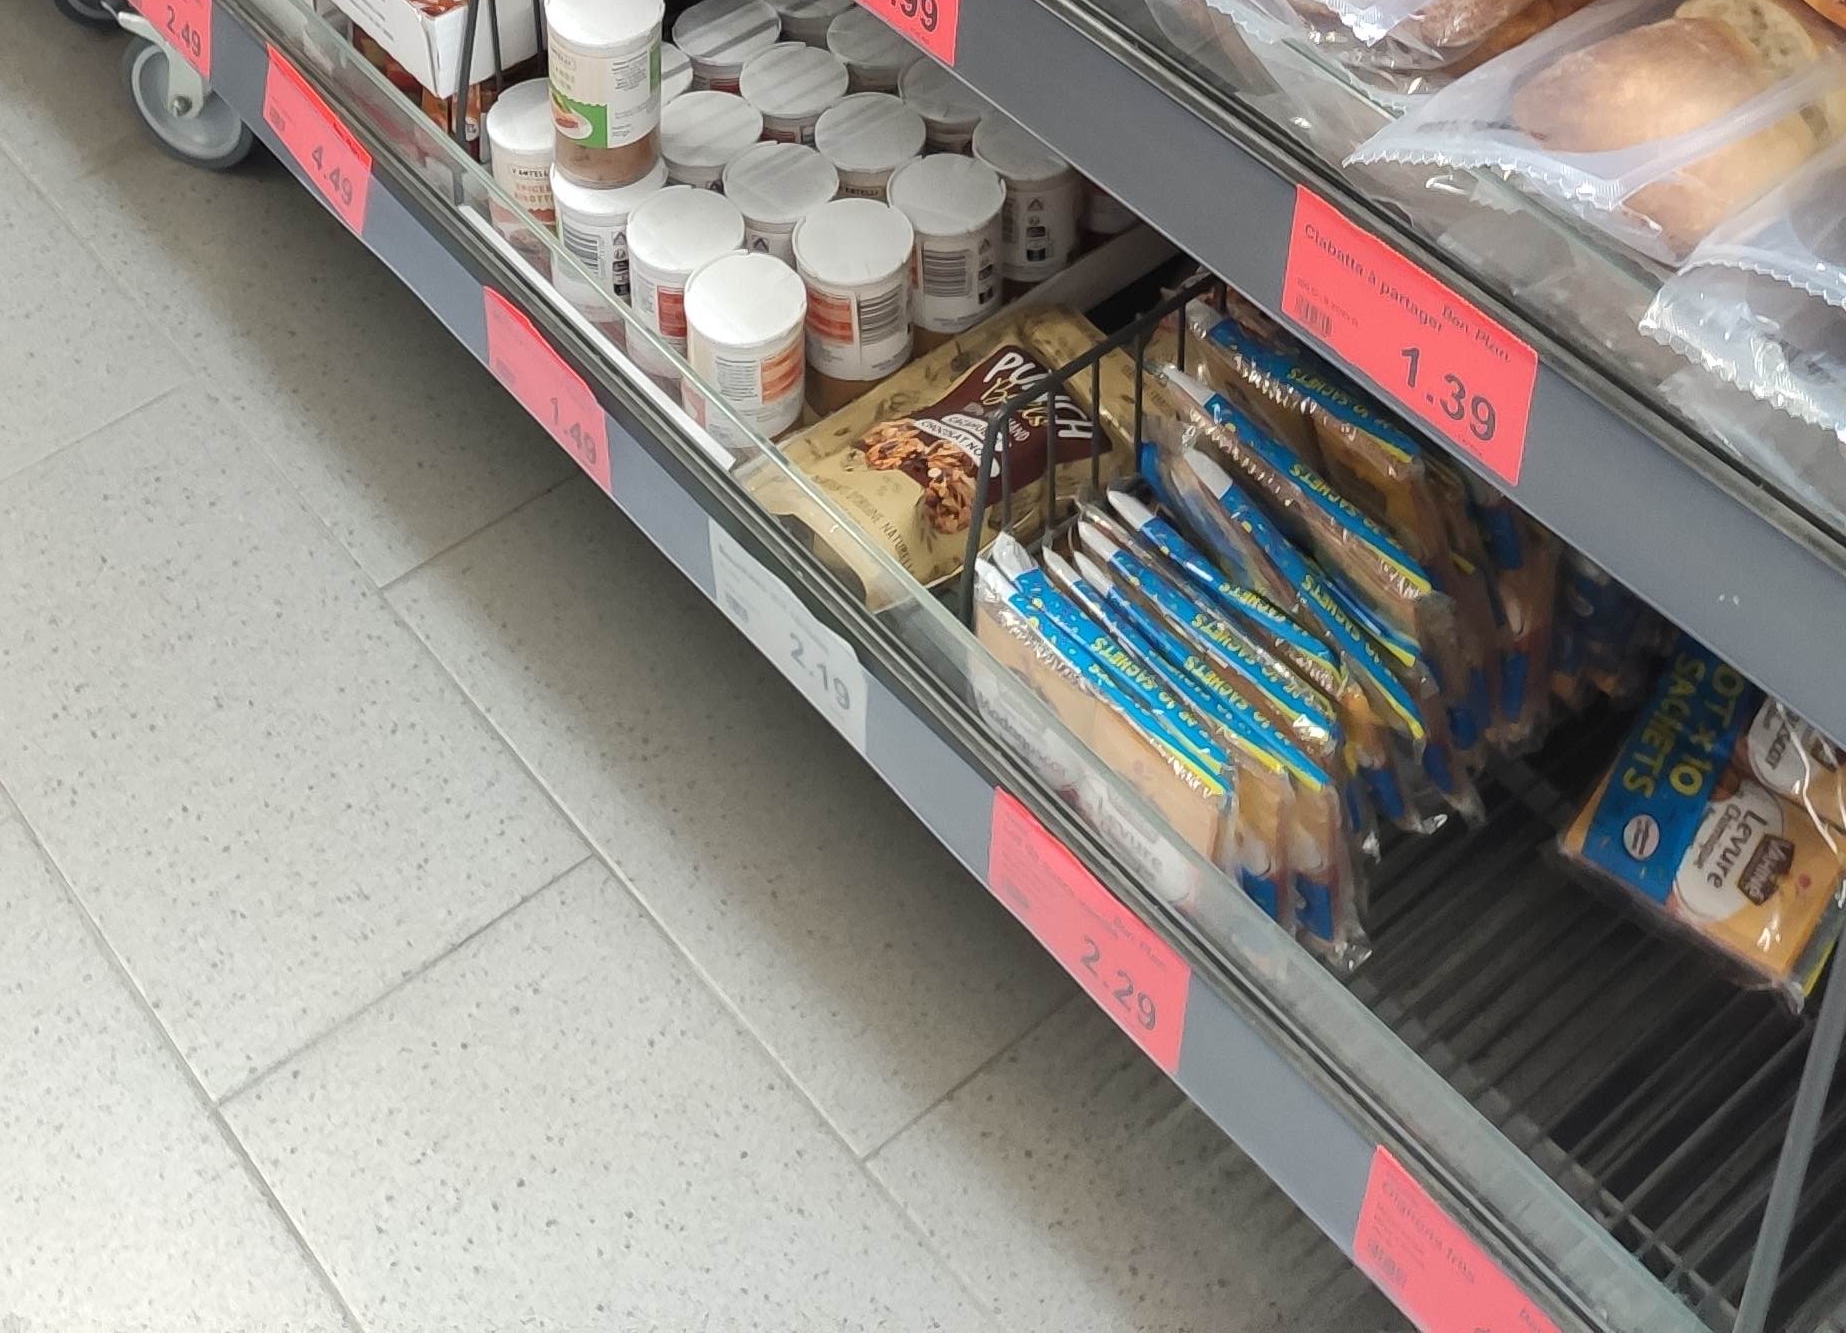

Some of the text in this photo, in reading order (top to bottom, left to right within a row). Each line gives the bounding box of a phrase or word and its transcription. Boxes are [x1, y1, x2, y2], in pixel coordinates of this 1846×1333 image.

[165, 4, 201, 58] 2.49
[310, 144, 354, 207] 4.49
[1304, 223, 1365, 278] Ciabatta
[1366, 270, 1377, 287] à
[1378, 282, 1443, 333] partager
[1442, 303, 1469, 334] Bon
[1400, 346, 1497, 442] 1.39
[789, 631, 851, 711] 2.19
[1091, 636, 1159, 691] SACHETS
[1706, 662, 1747, 730] OT
[1622, 652, 1708, 799] SACHETS
[1705, 808, 1769, 891] Levure
[1079, 936, 1158, 1032] 2.29
